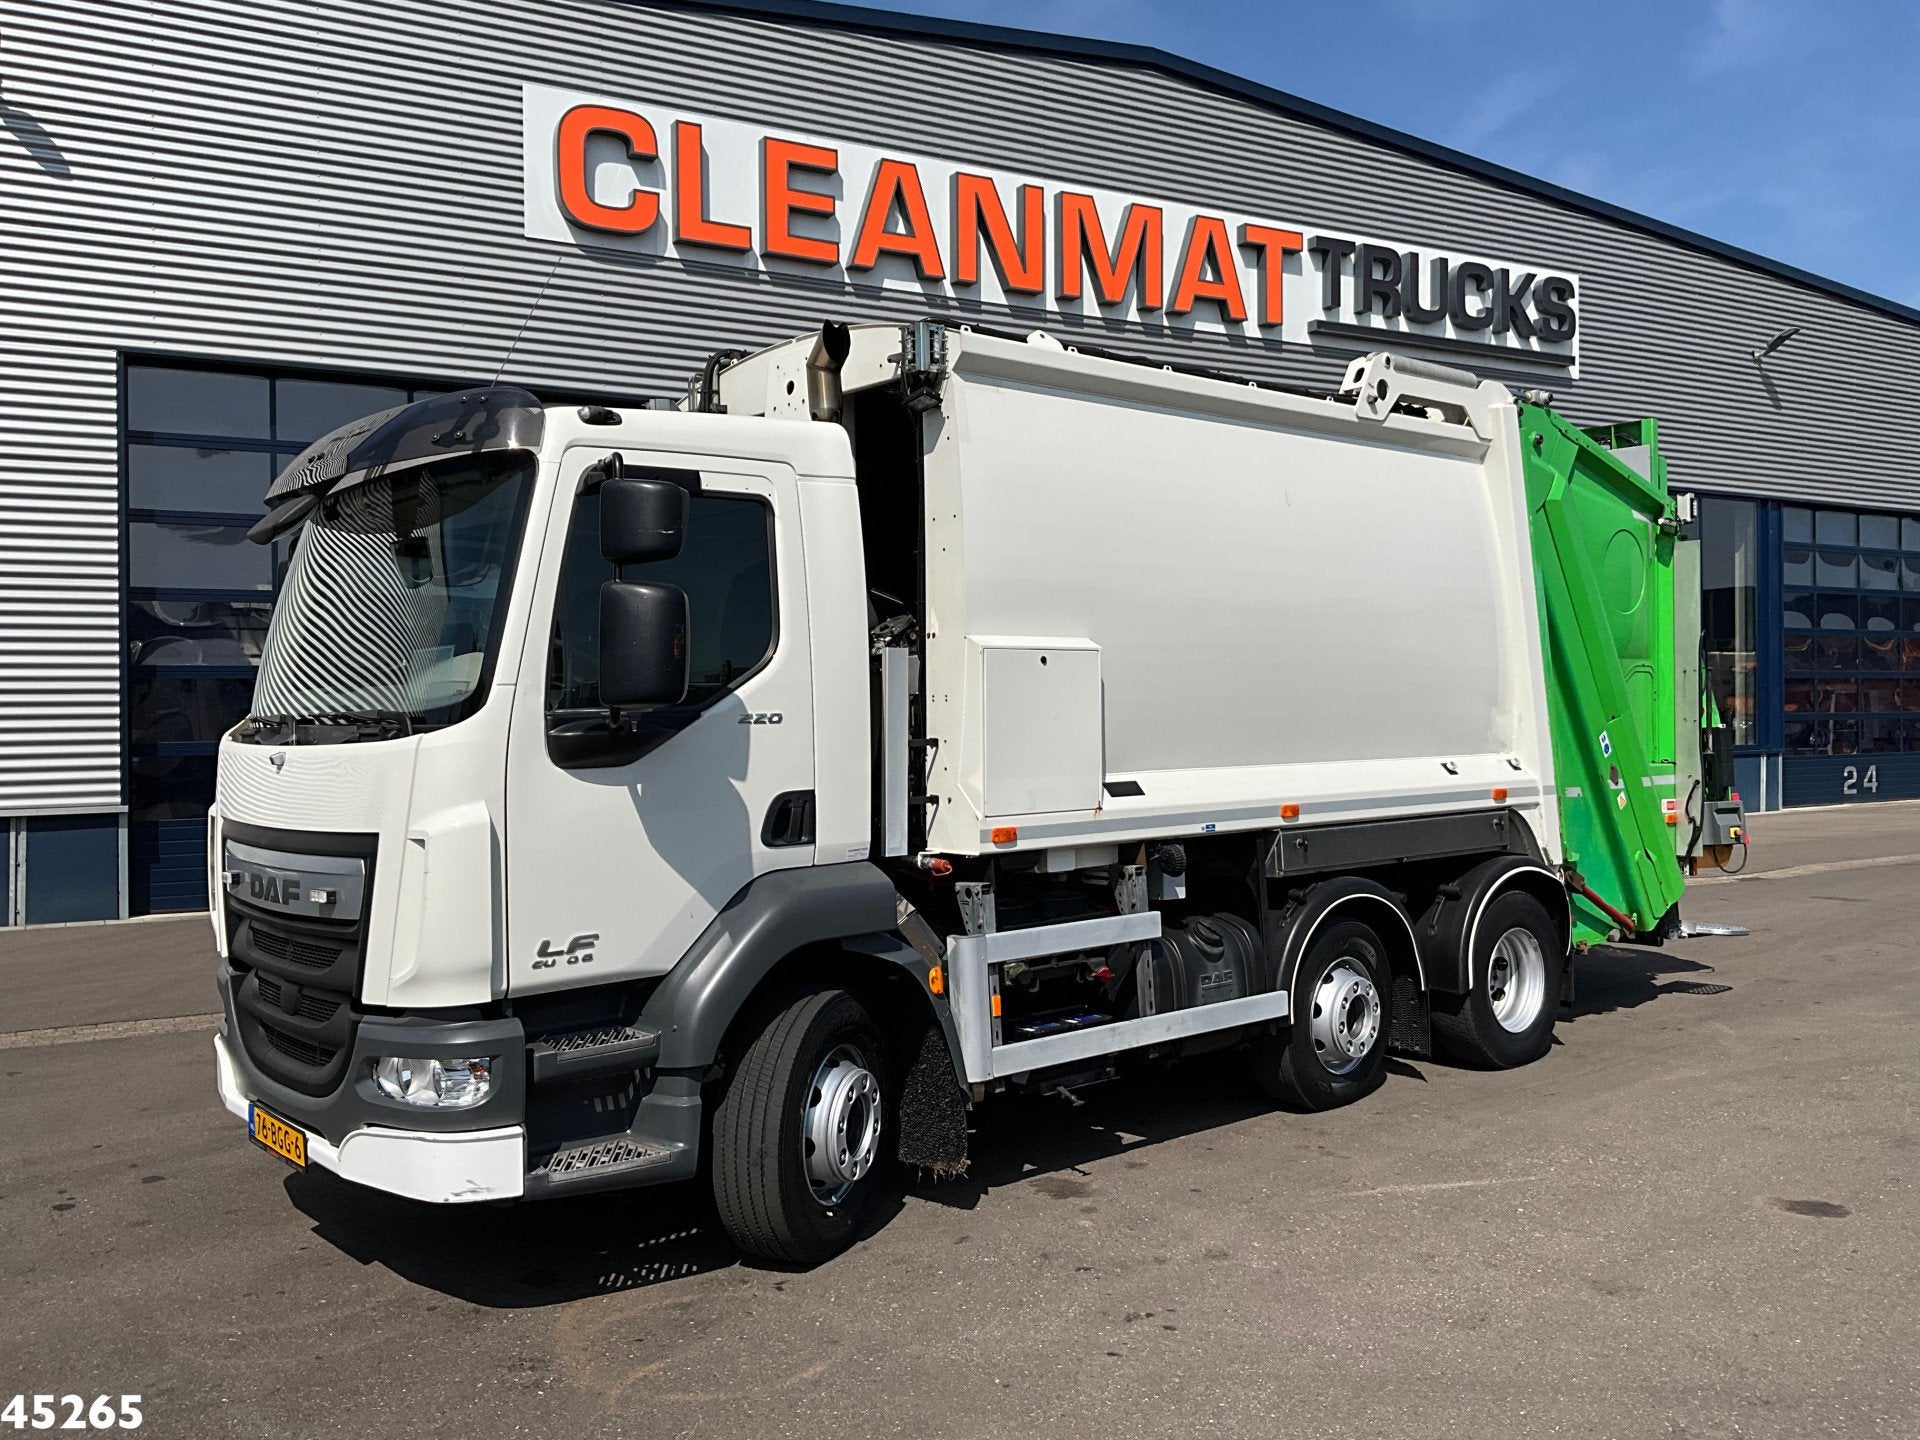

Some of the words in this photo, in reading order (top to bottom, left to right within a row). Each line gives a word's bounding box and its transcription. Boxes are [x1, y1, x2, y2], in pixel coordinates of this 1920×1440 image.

[556, 104, 1303, 327] CLEANMAT
[1308, 235, 1577, 343] TRUCKS
[738, 713, 783, 724] 220
[1843, 765, 1878, 794] 24
[250, 873, 301, 905] DAF
[537, 933, 600, 958] LF
[256, 1112, 302, 1160] 76-BGG-6
